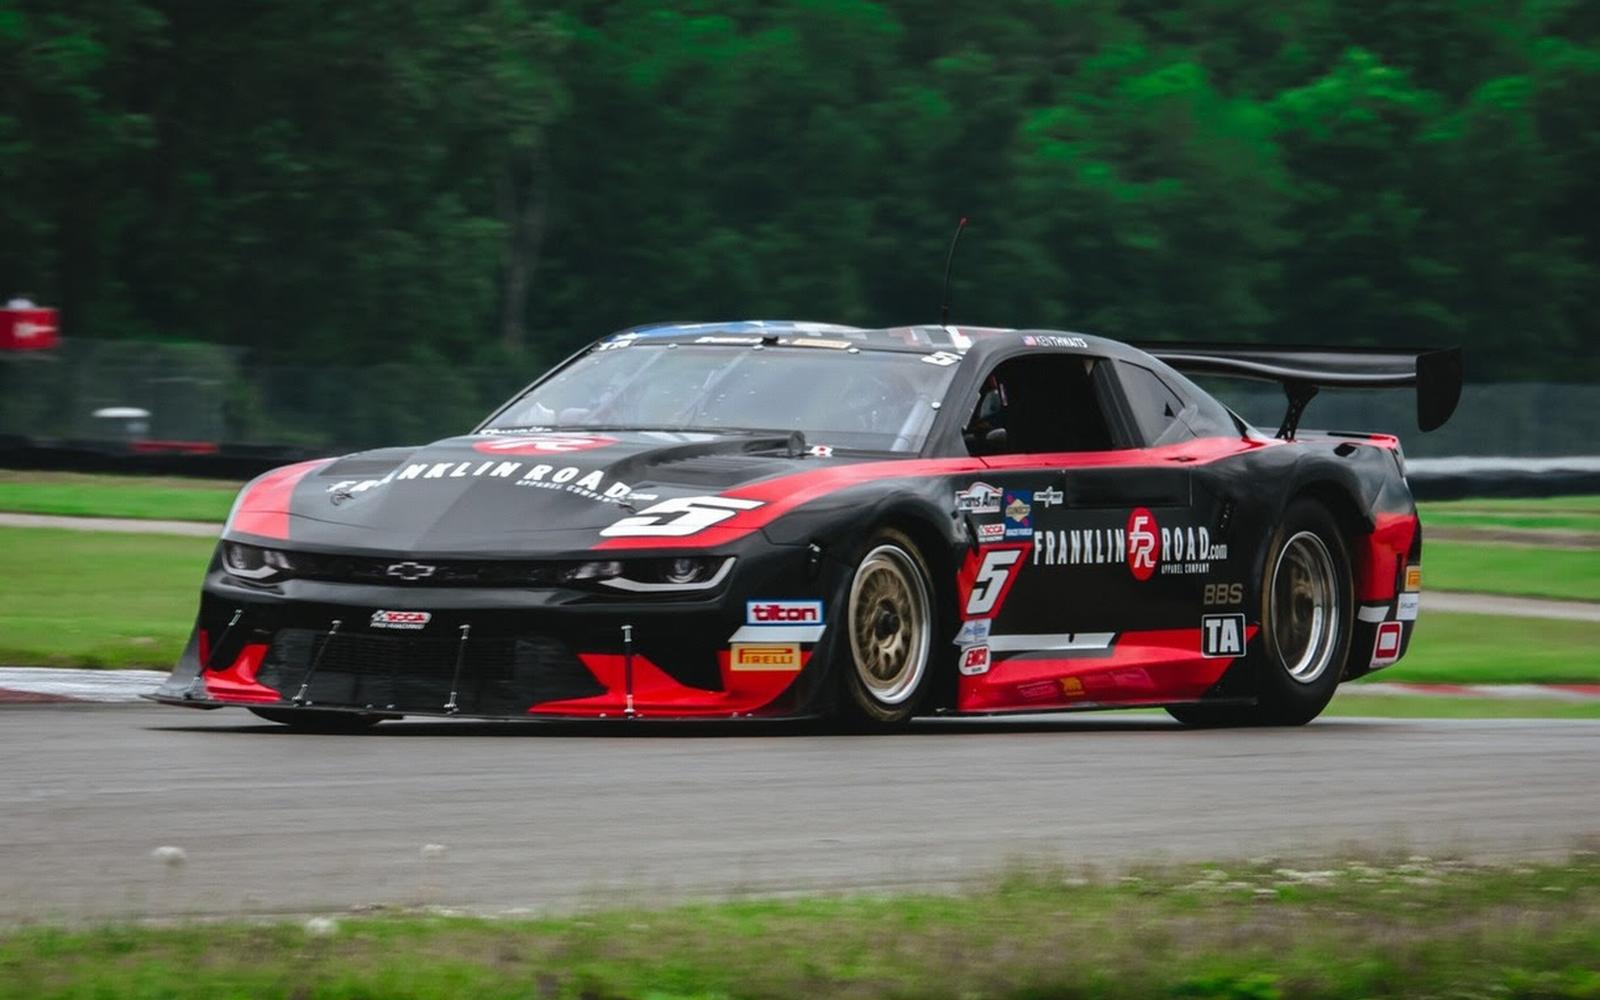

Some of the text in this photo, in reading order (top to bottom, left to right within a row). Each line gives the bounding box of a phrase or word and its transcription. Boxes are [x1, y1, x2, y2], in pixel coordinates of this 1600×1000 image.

[599, 495, 767, 537] 5
[1033, 529, 1125, 565] FRANKLIN
[966, 549, 1022, 614] 5
[1185, 562, 1210, 574] COMPANY
[1203, 582, 1244, 605] BBS
[753, 604, 817, 621] tilton
[1206, 618, 1240, 653] TA
[738, 647, 794, 664] PIRELLI
